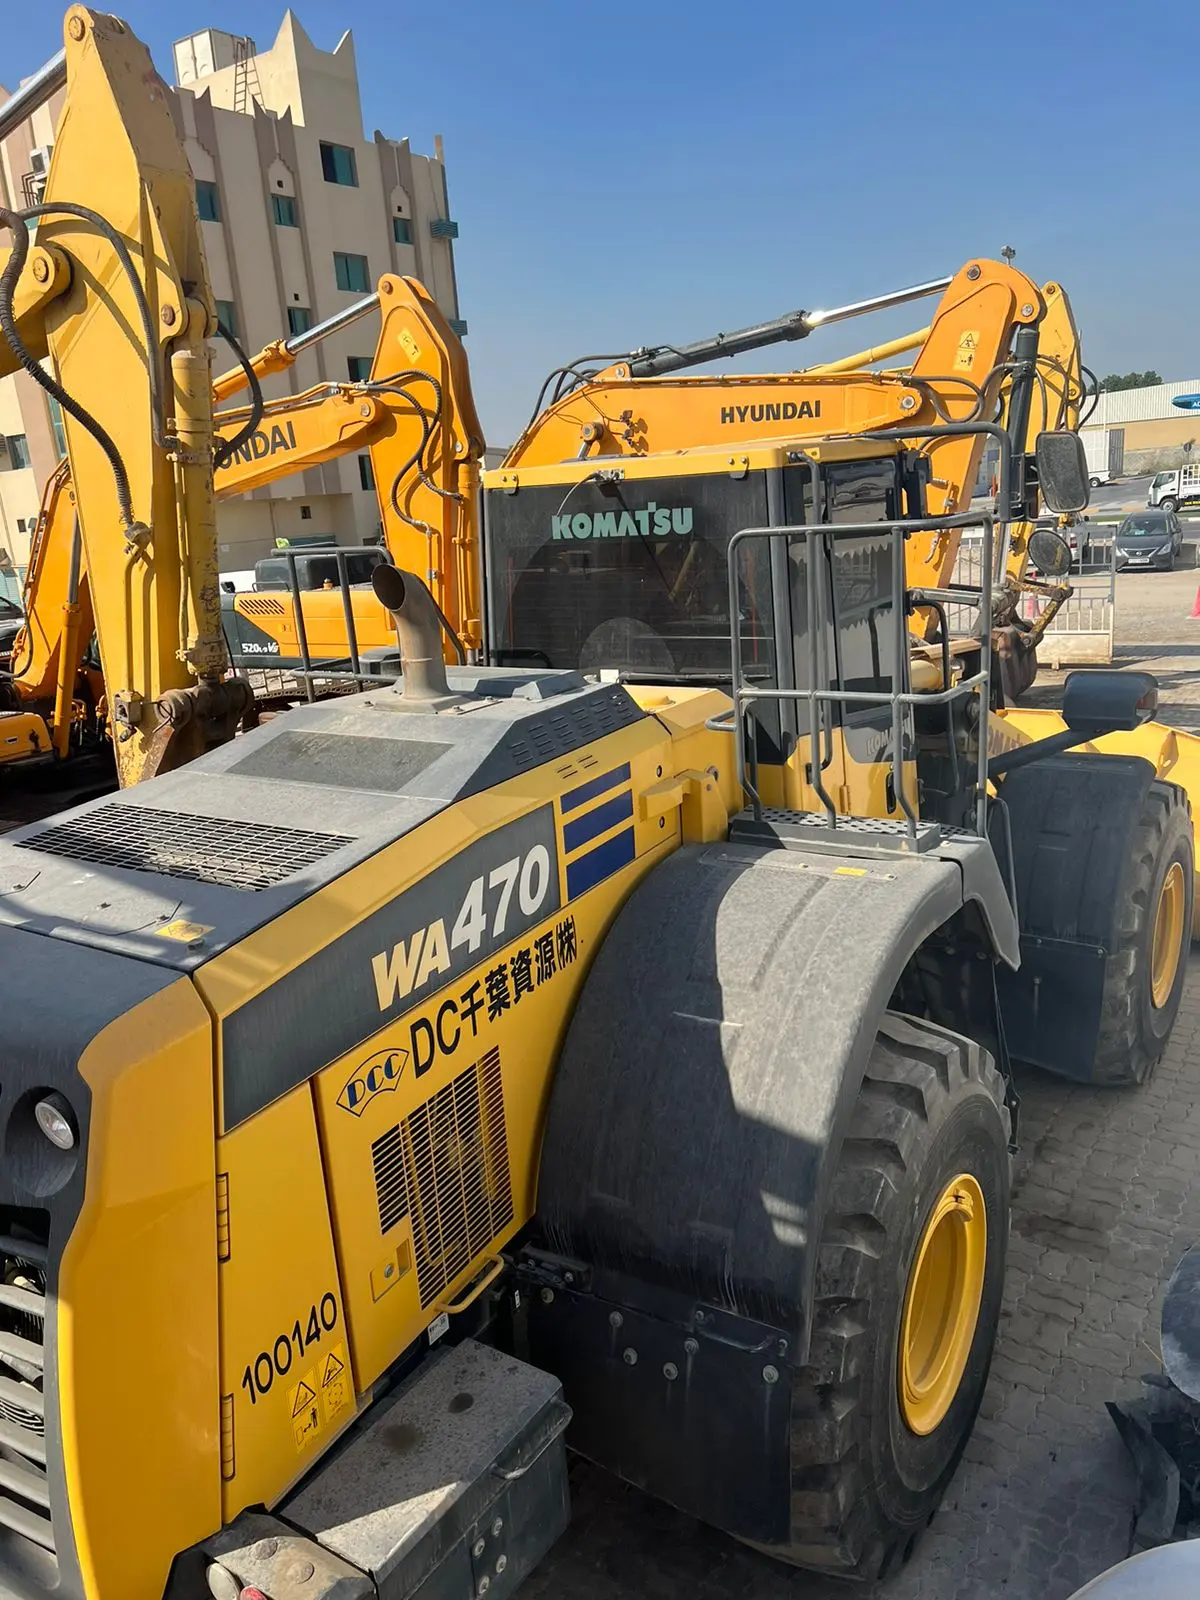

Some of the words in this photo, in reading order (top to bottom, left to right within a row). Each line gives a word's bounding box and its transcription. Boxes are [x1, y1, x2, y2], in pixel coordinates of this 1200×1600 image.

[720, 400, 821, 424] HYUNDAI
[551, 501, 693, 540] KOMATSU
[371, 844, 550, 1012] WA470
[346, 1053, 401, 1109] DCC
[241, 1291, 338, 1405] 100140
